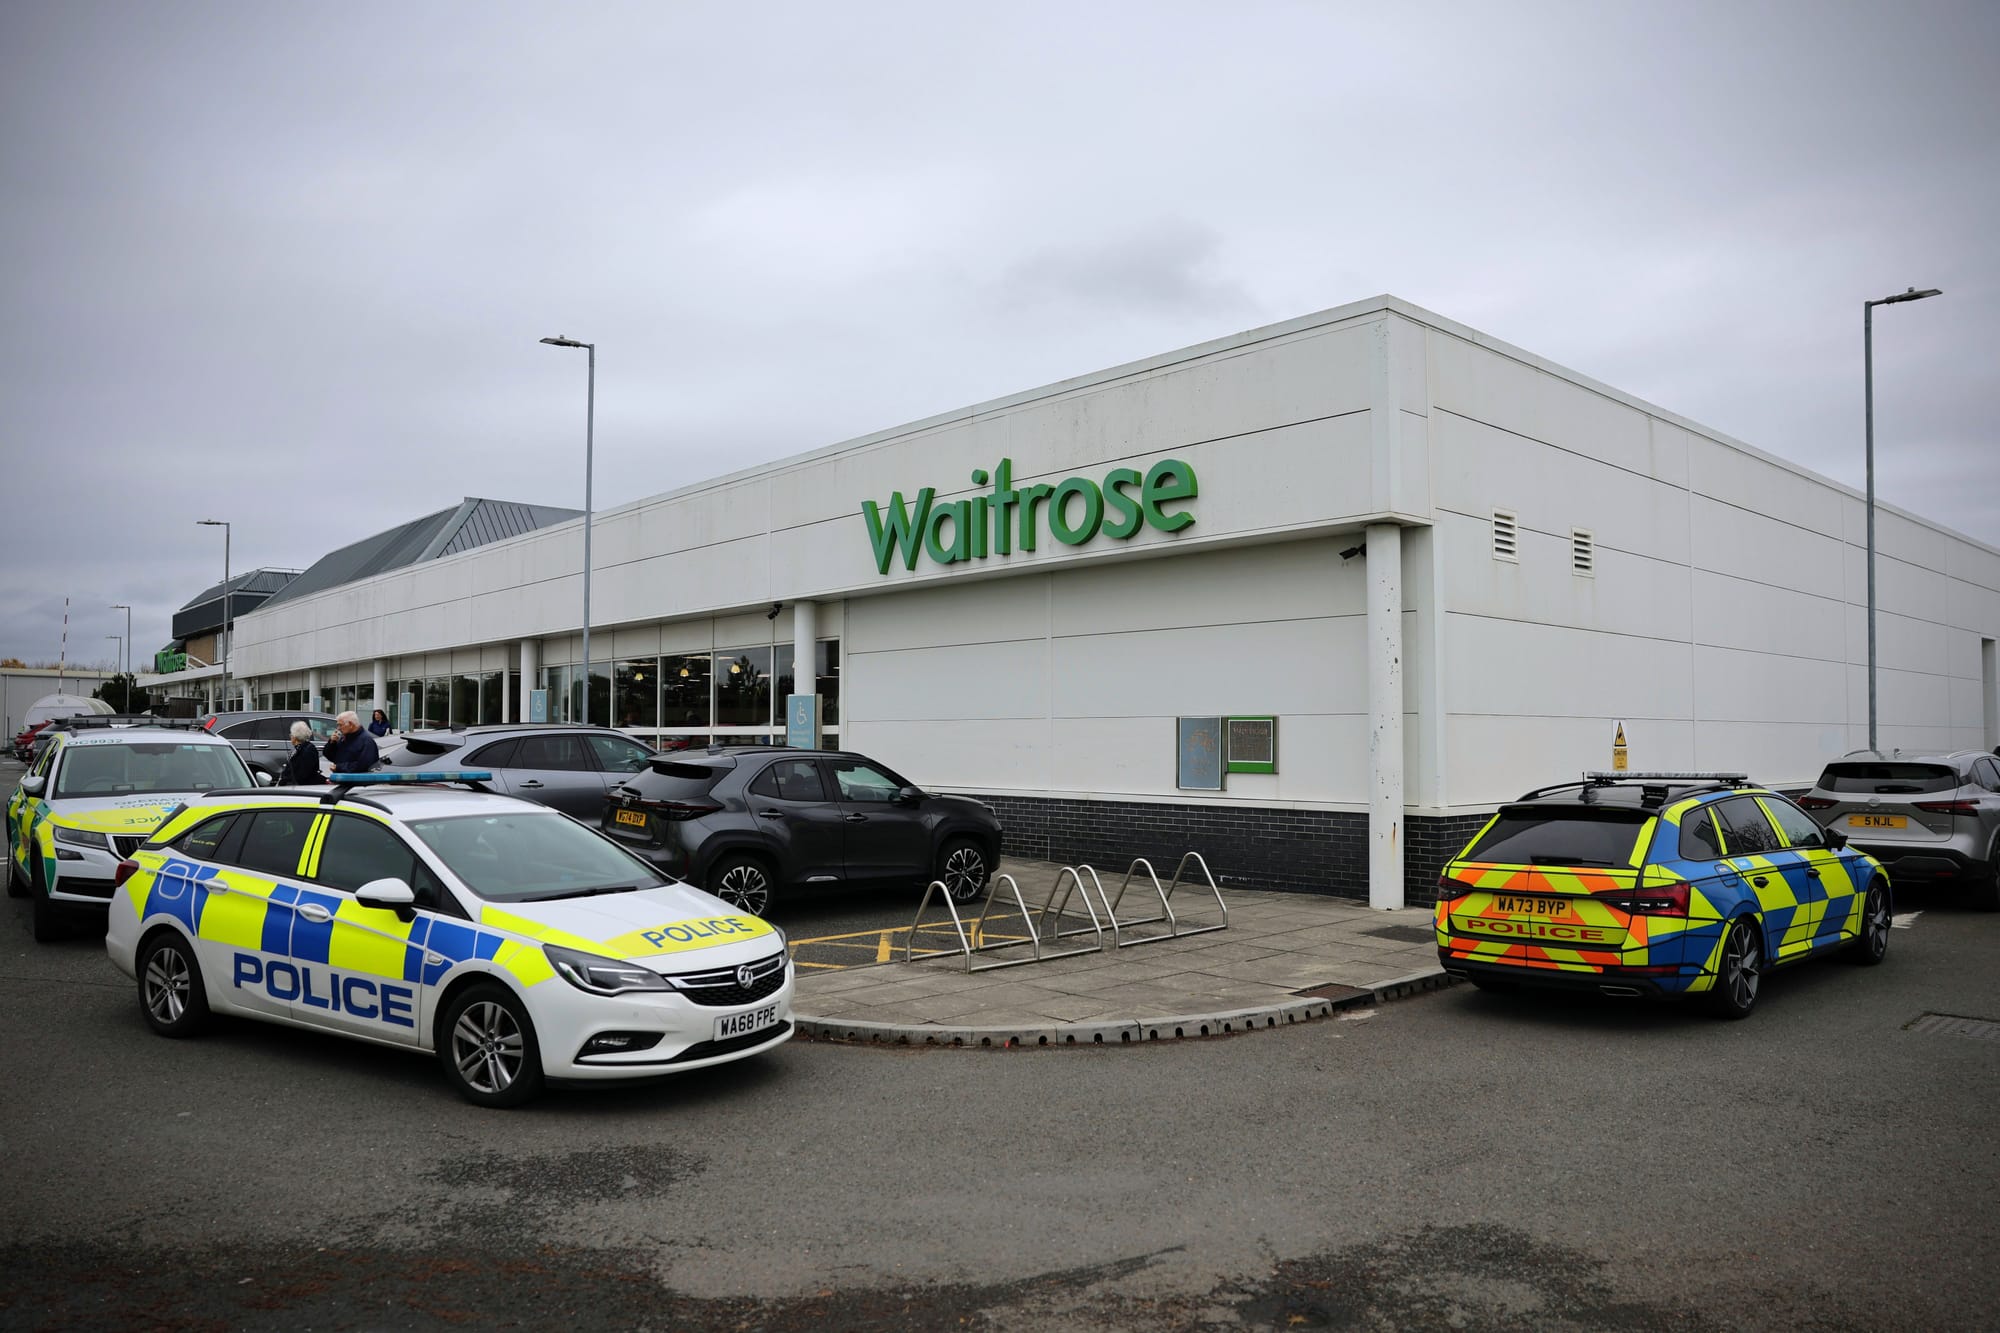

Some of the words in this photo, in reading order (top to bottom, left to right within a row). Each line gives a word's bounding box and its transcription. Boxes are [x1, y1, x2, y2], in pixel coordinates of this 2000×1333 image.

[861, 458, 1198, 575] Waitrose
[1864, 816, 1871, 825] 5
[1873, 816, 1894, 826] NJL
[1498, 897, 1533, 913] WA73
[1537, 899, 1566, 915] BYP
[641, 918, 754, 948] POLICE
[1467, 919, 1605, 941] POLICE
[233, 952, 414, 1028] POLICE
[721, 1013, 754, 1036] WA68
[757, 1006, 776, 1027] FPE
